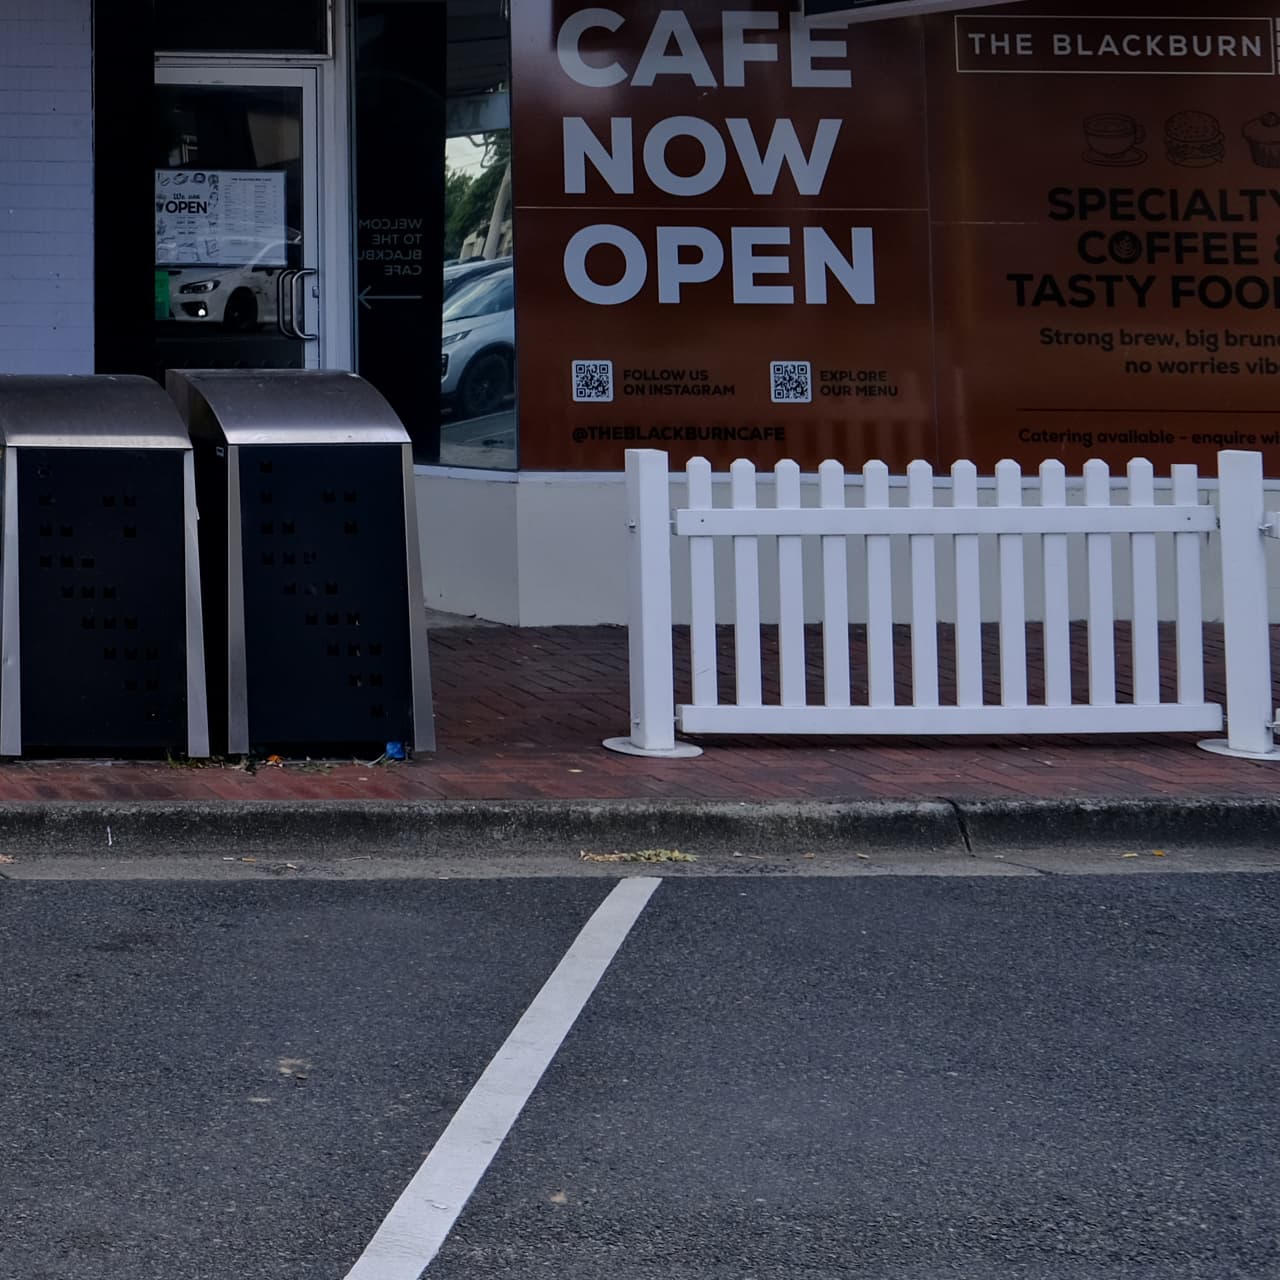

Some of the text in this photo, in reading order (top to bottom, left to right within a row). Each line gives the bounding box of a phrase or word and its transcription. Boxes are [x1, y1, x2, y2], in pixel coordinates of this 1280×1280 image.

[556, 6, 853, 89] CAFE
[968, 33, 1262, 57] THE BLACKBURN
[563, 115, 843, 196] NOW
[166, 201, 208, 213] OPEN
[1078, 230, 1258, 264] COFFEE
[563, 224, 877, 306] OPEN
[1006, 273, 1280, 308] TASTY FOO
[1040, 328, 1114, 351] Strong
[1120, 329, 1178, 347] brew,
[1186, 329, 1218, 352] big
[623, 370, 709, 381] FOLLOW US
[1125, 357, 1240, 374] no worries
[820, 370, 887, 382] EXPLORE
[624, 384, 735, 396] ON INSTAGRAM
[820, 385, 898, 397] OUR MENU
[572, 426, 785, 442] @THEBLACKBURNCAFE
[1019, 428, 1256, 448] Catering available enquire
